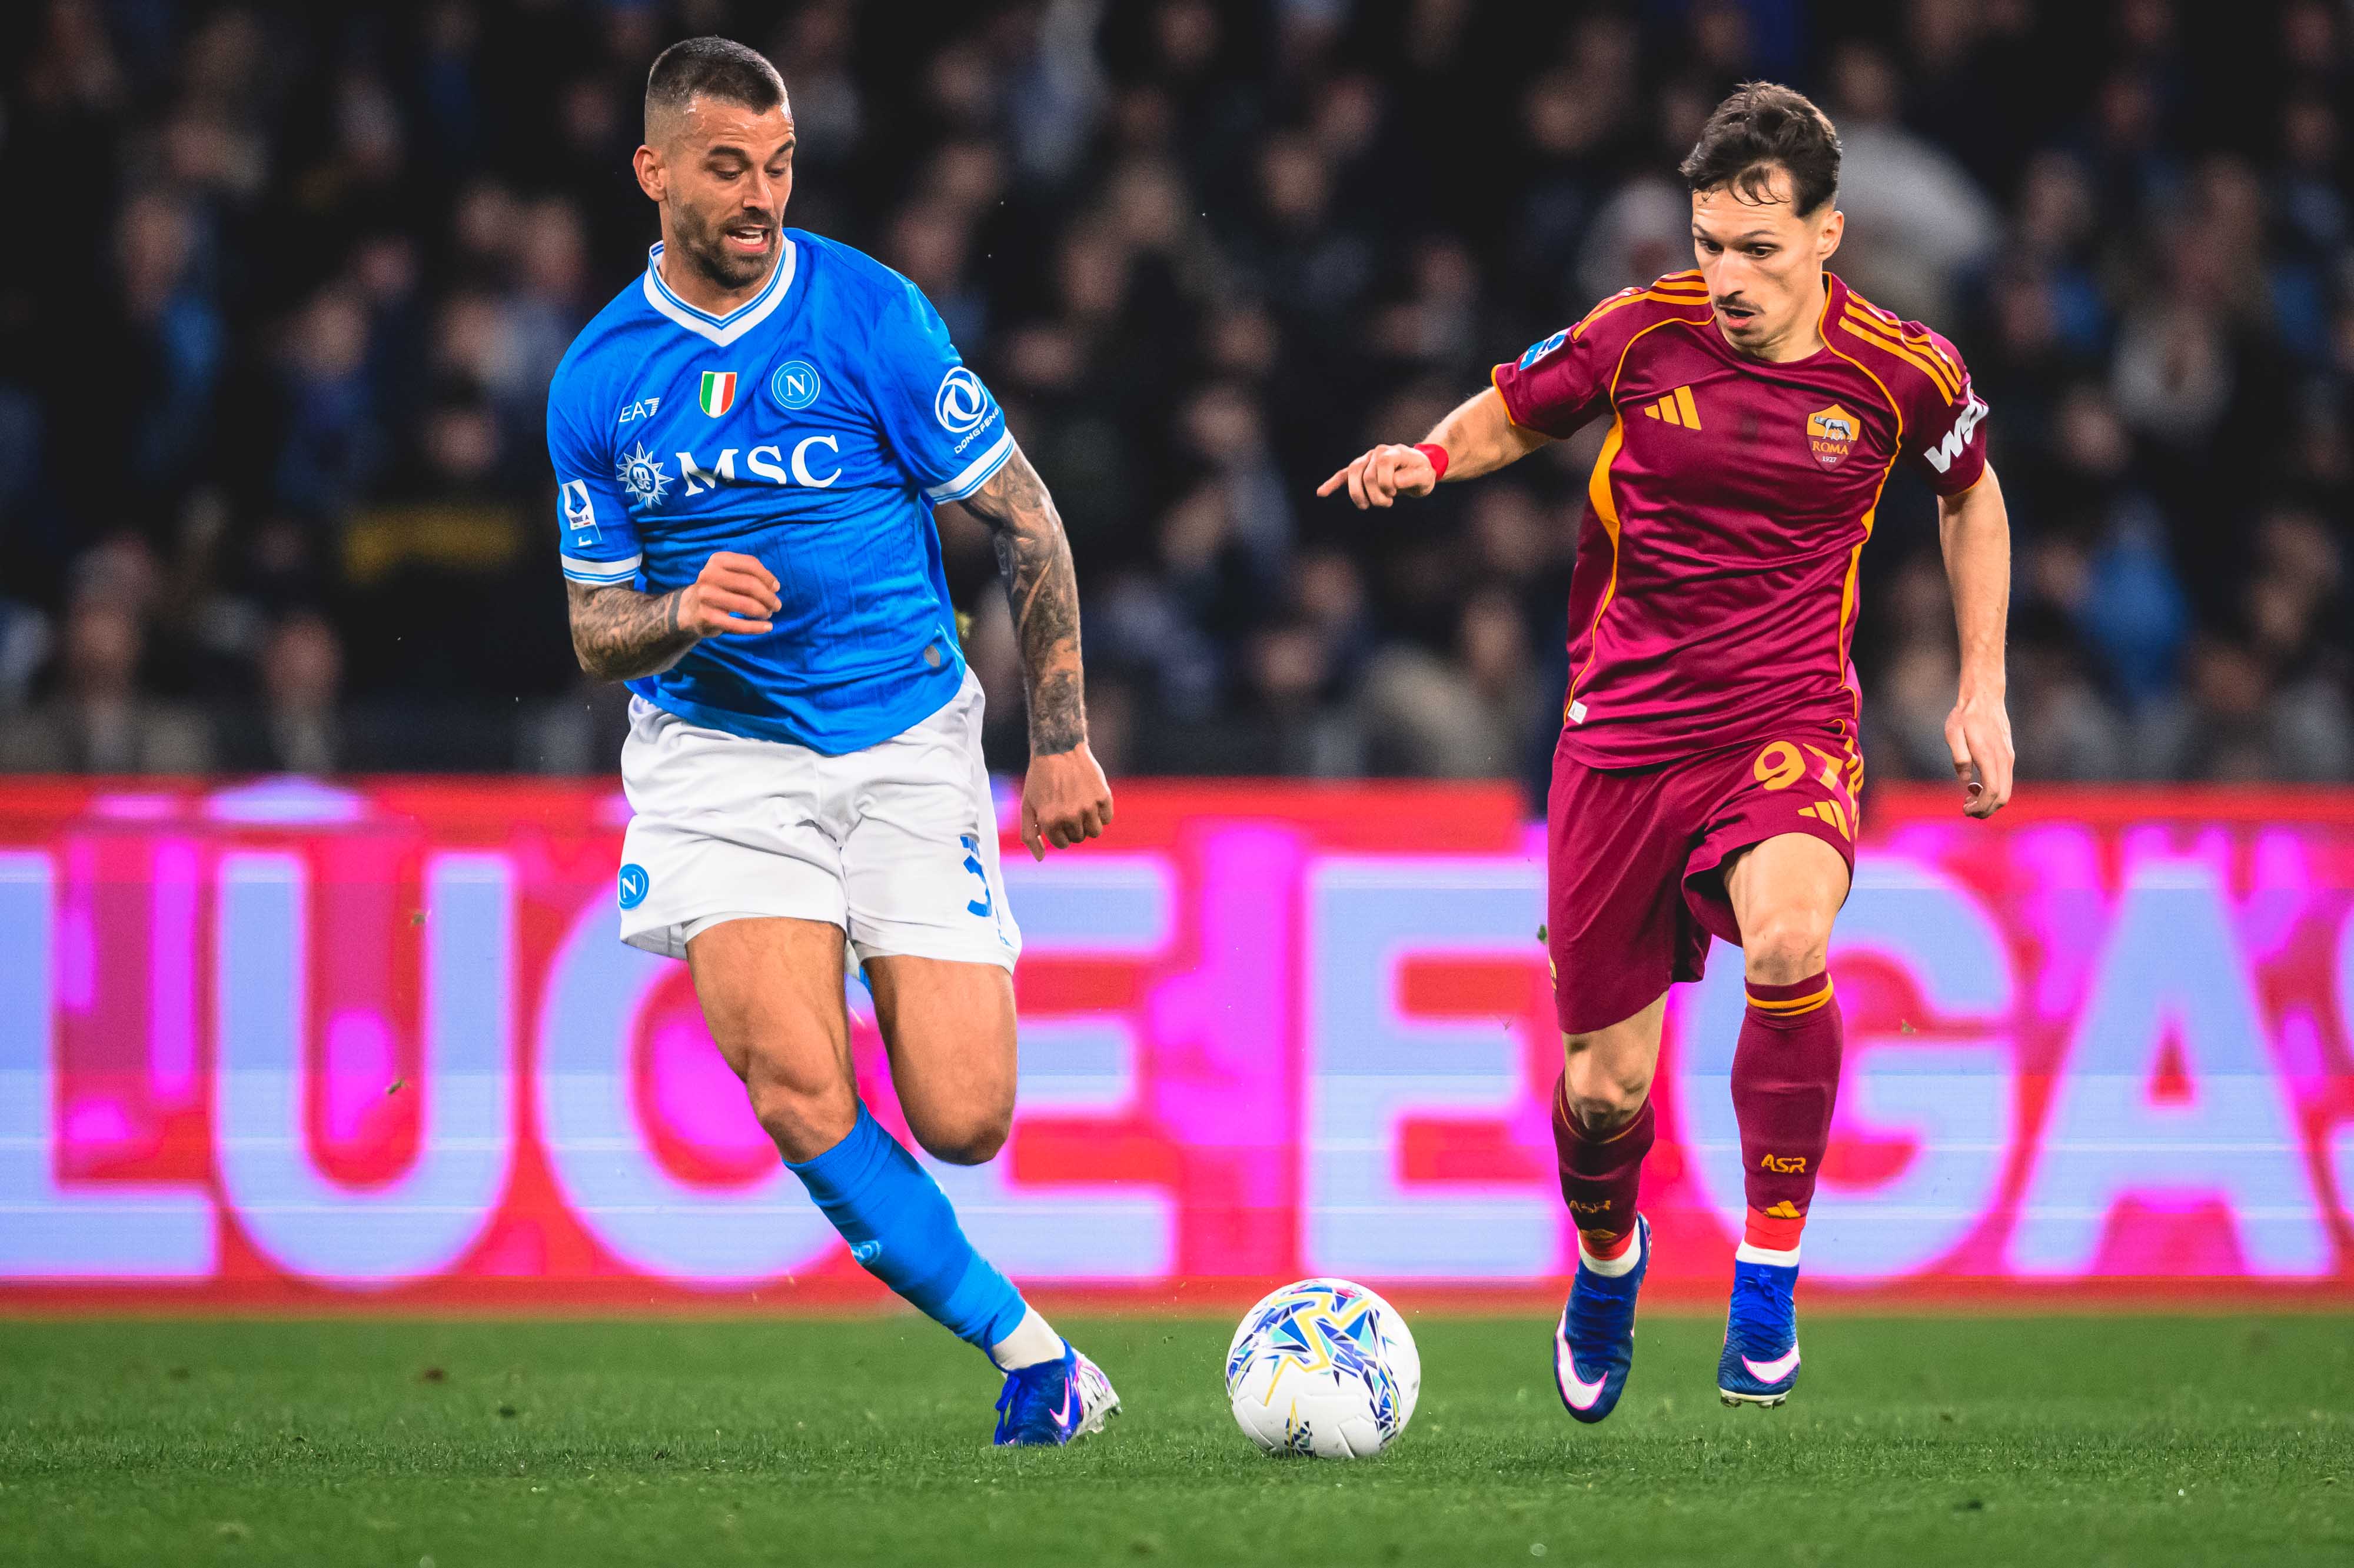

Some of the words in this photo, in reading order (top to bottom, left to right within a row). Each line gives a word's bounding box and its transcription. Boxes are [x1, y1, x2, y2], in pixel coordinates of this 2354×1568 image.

[785, 374, 806, 397] N
[619, 397, 660, 423] EA7
[953, 407, 1000, 454] DONGFENG
[1812, 440, 1849, 455] ROMA
[676, 434, 842, 497] MSC
[621, 874, 637, 899] N
[0, 850, 1171, 1289] LUCE
[1305, 853, 1562, 1286] E
[1670, 850, 2354, 1289] GA
[1761, 1153, 1806, 1174] ASR
